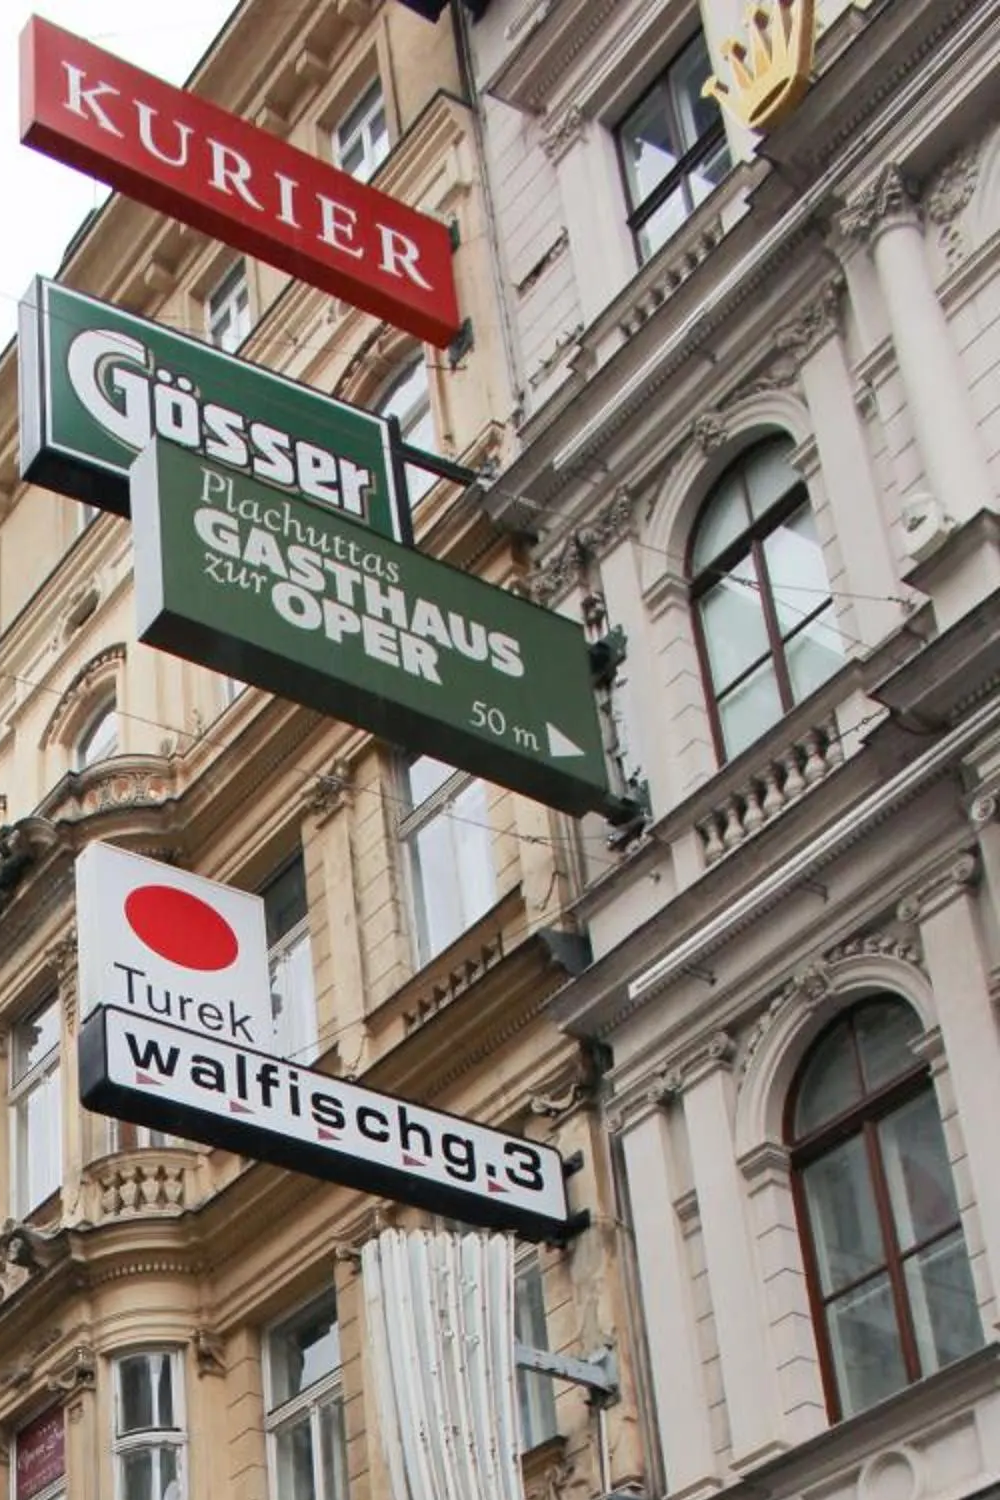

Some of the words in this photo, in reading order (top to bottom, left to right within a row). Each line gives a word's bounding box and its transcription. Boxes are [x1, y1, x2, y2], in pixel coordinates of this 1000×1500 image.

[60, 61, 434, 292] KURIER
[67, 328, 375, 518] Gösser
[194, 507, 525, 678] GASTHAUS
[201, 467, 401, 584] Plachuttas
[204, 548, 268, 595] zur
[271, 580, 443, 685] OPER
[470, 701, 506, 735] 50
[512, 725, 540, 751] m
[113, 963, 256, 1043] Turek
[124, 1029, 544, 1192] walfischg.3
